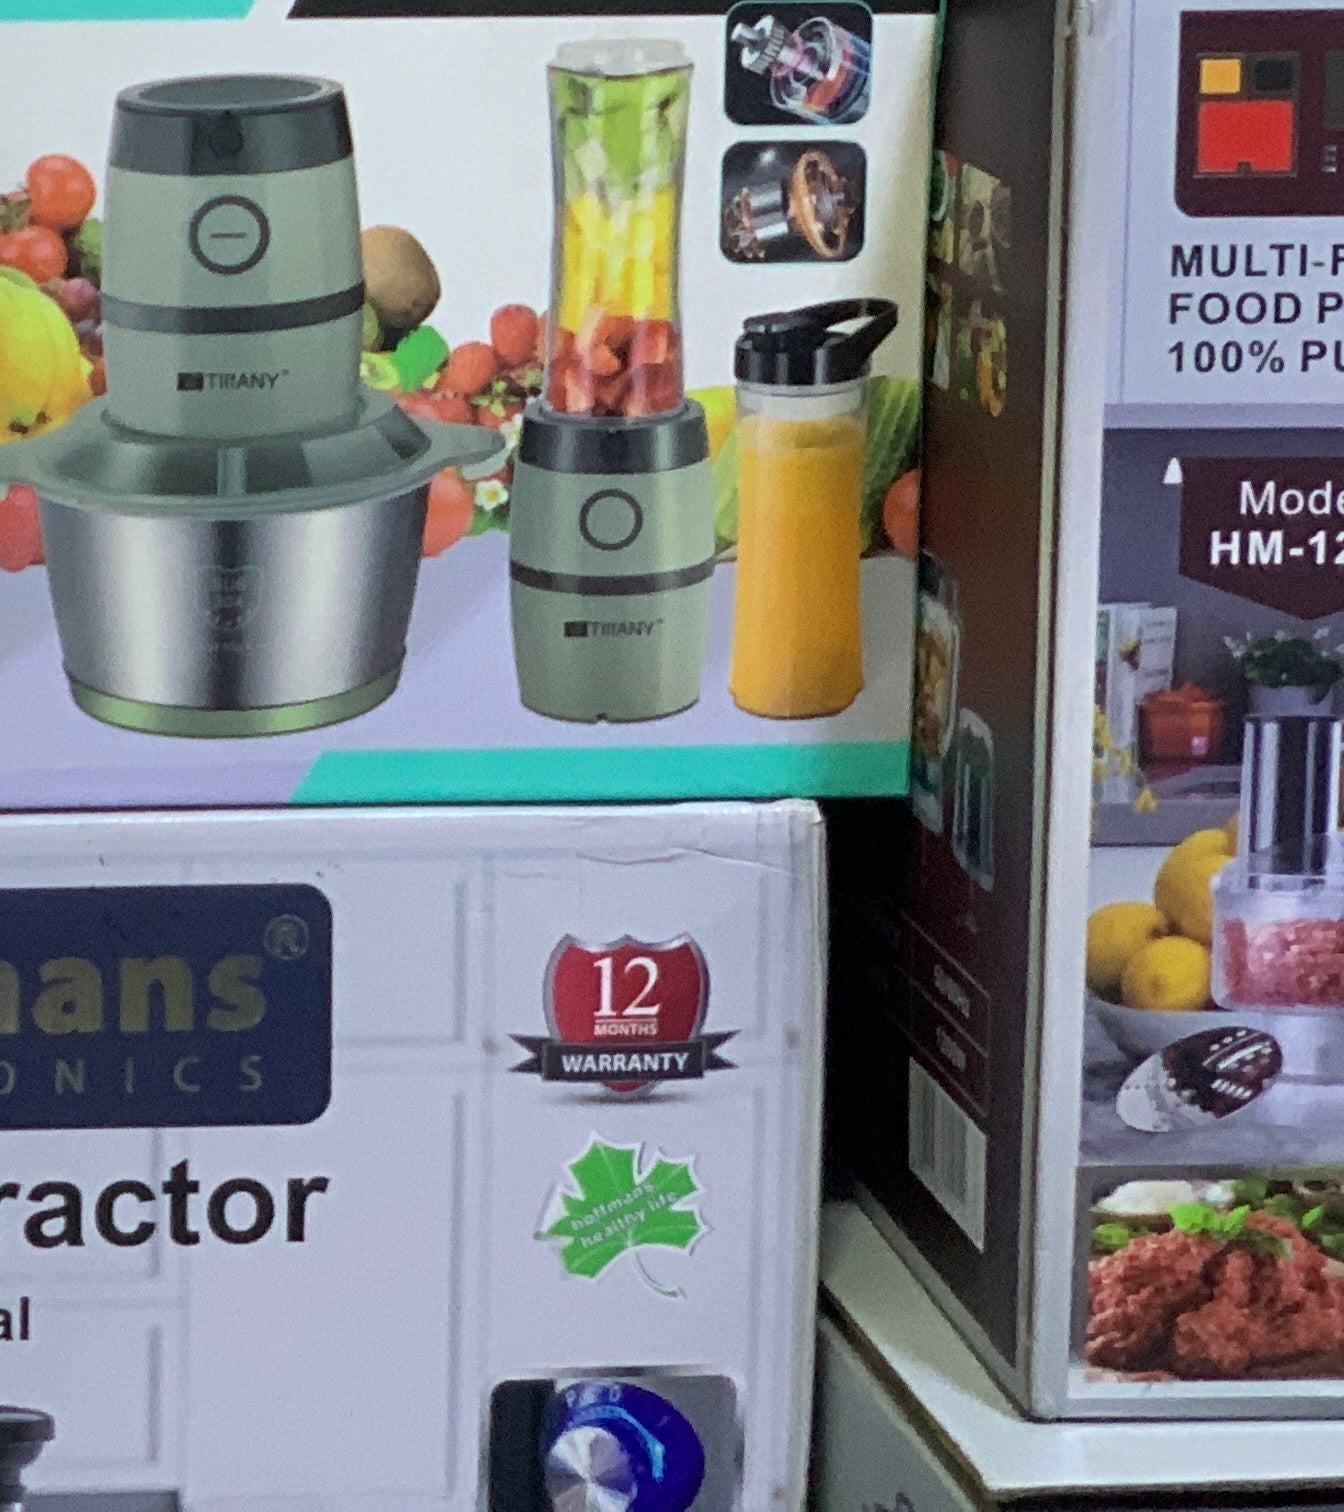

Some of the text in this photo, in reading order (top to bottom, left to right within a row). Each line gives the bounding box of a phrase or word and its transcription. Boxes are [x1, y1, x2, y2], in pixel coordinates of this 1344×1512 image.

[1168, 291, 1302, 326] FOOD
[1167, 339, 1286, 374] 100%
[592, 956, 663, 1018] 12
[593, 1022, 659, 1037] MONTHS
[561, 1051, 691, 1075] WARRANTY
